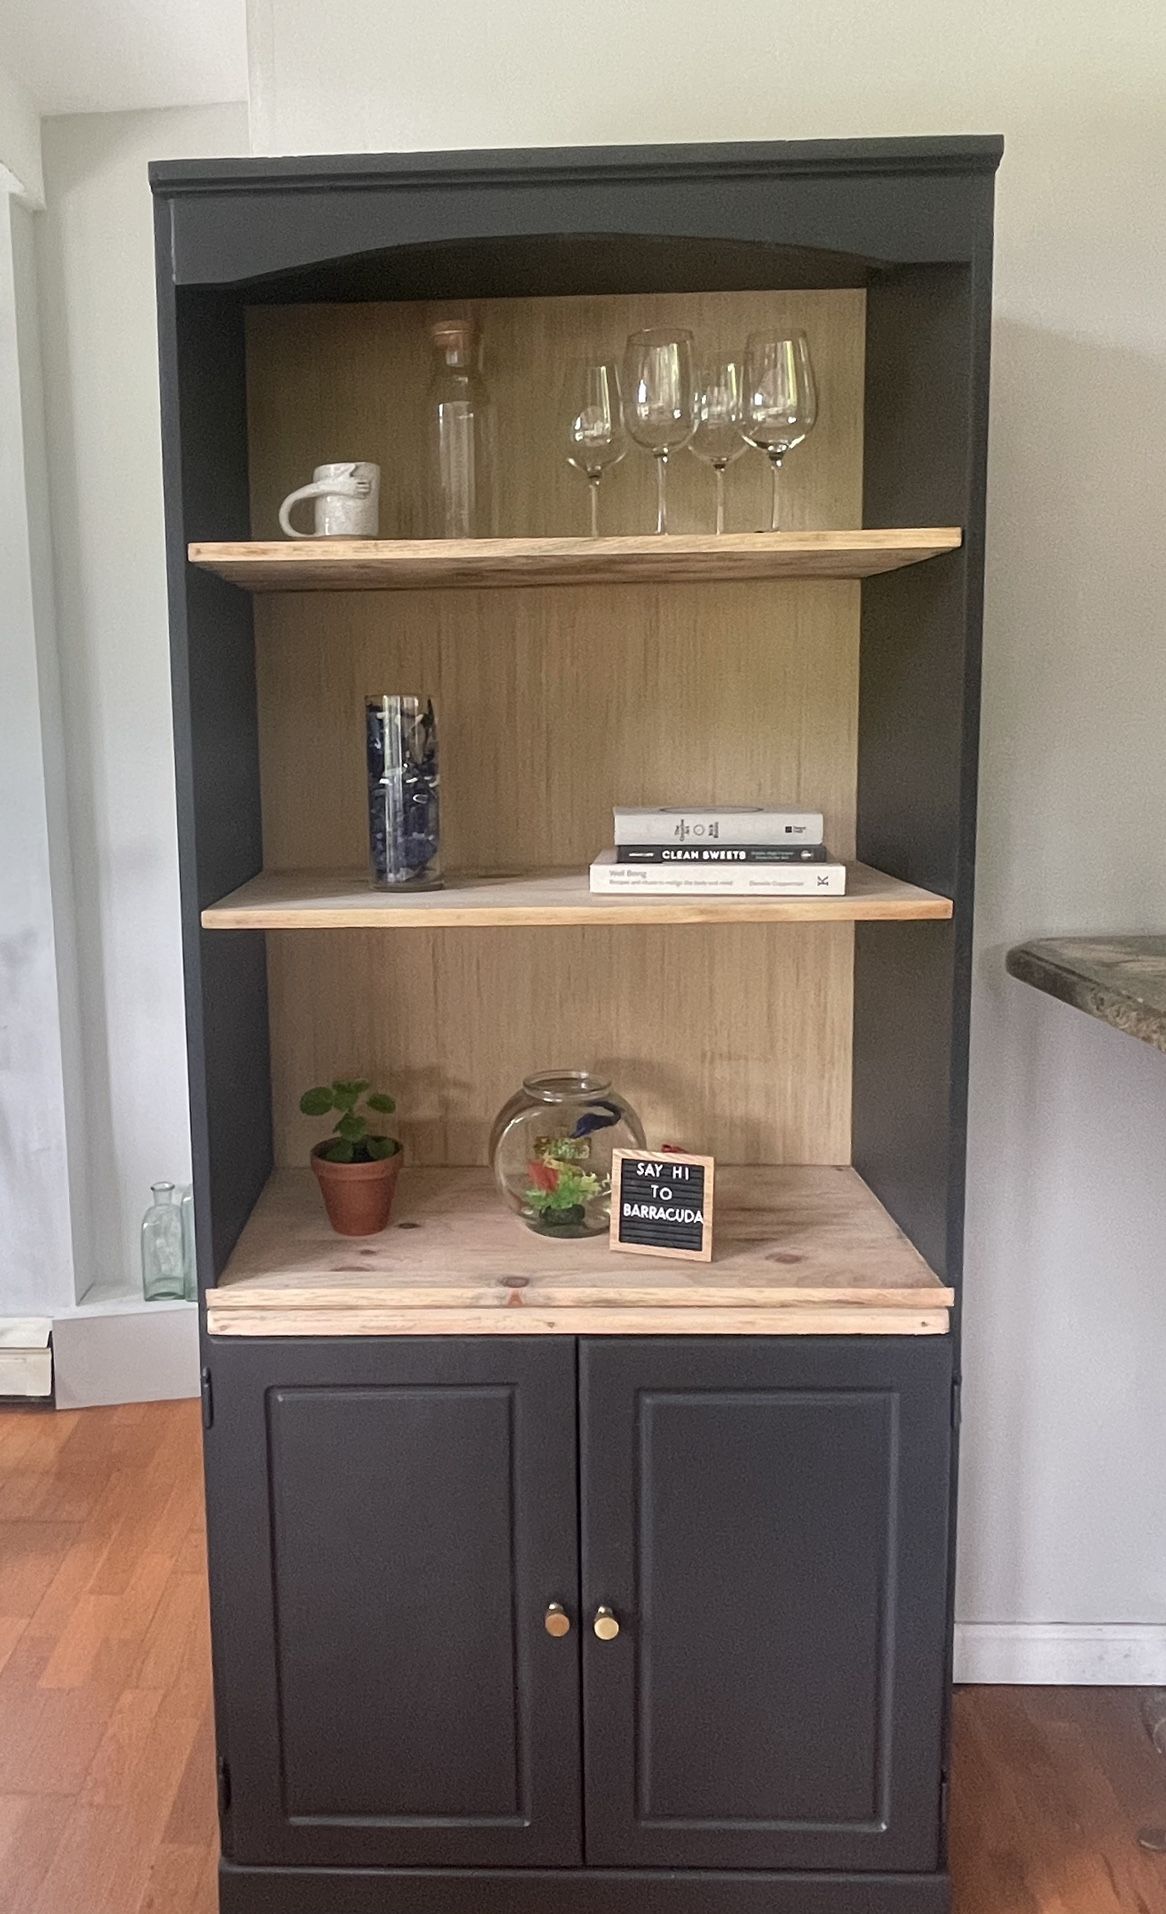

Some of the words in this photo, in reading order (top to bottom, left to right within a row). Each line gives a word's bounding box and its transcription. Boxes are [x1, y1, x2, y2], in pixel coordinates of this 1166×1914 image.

[661, 850, 699, 860] CLEAN
[702, 850, 746, 860] SWEETS
[636, 1162, 663, 1178] SAY
[672, 1165, 690, 1181] HI
[650, 1184, 673, 1201] TO
[623, 1202, 704, 1225] BARRACUDA
